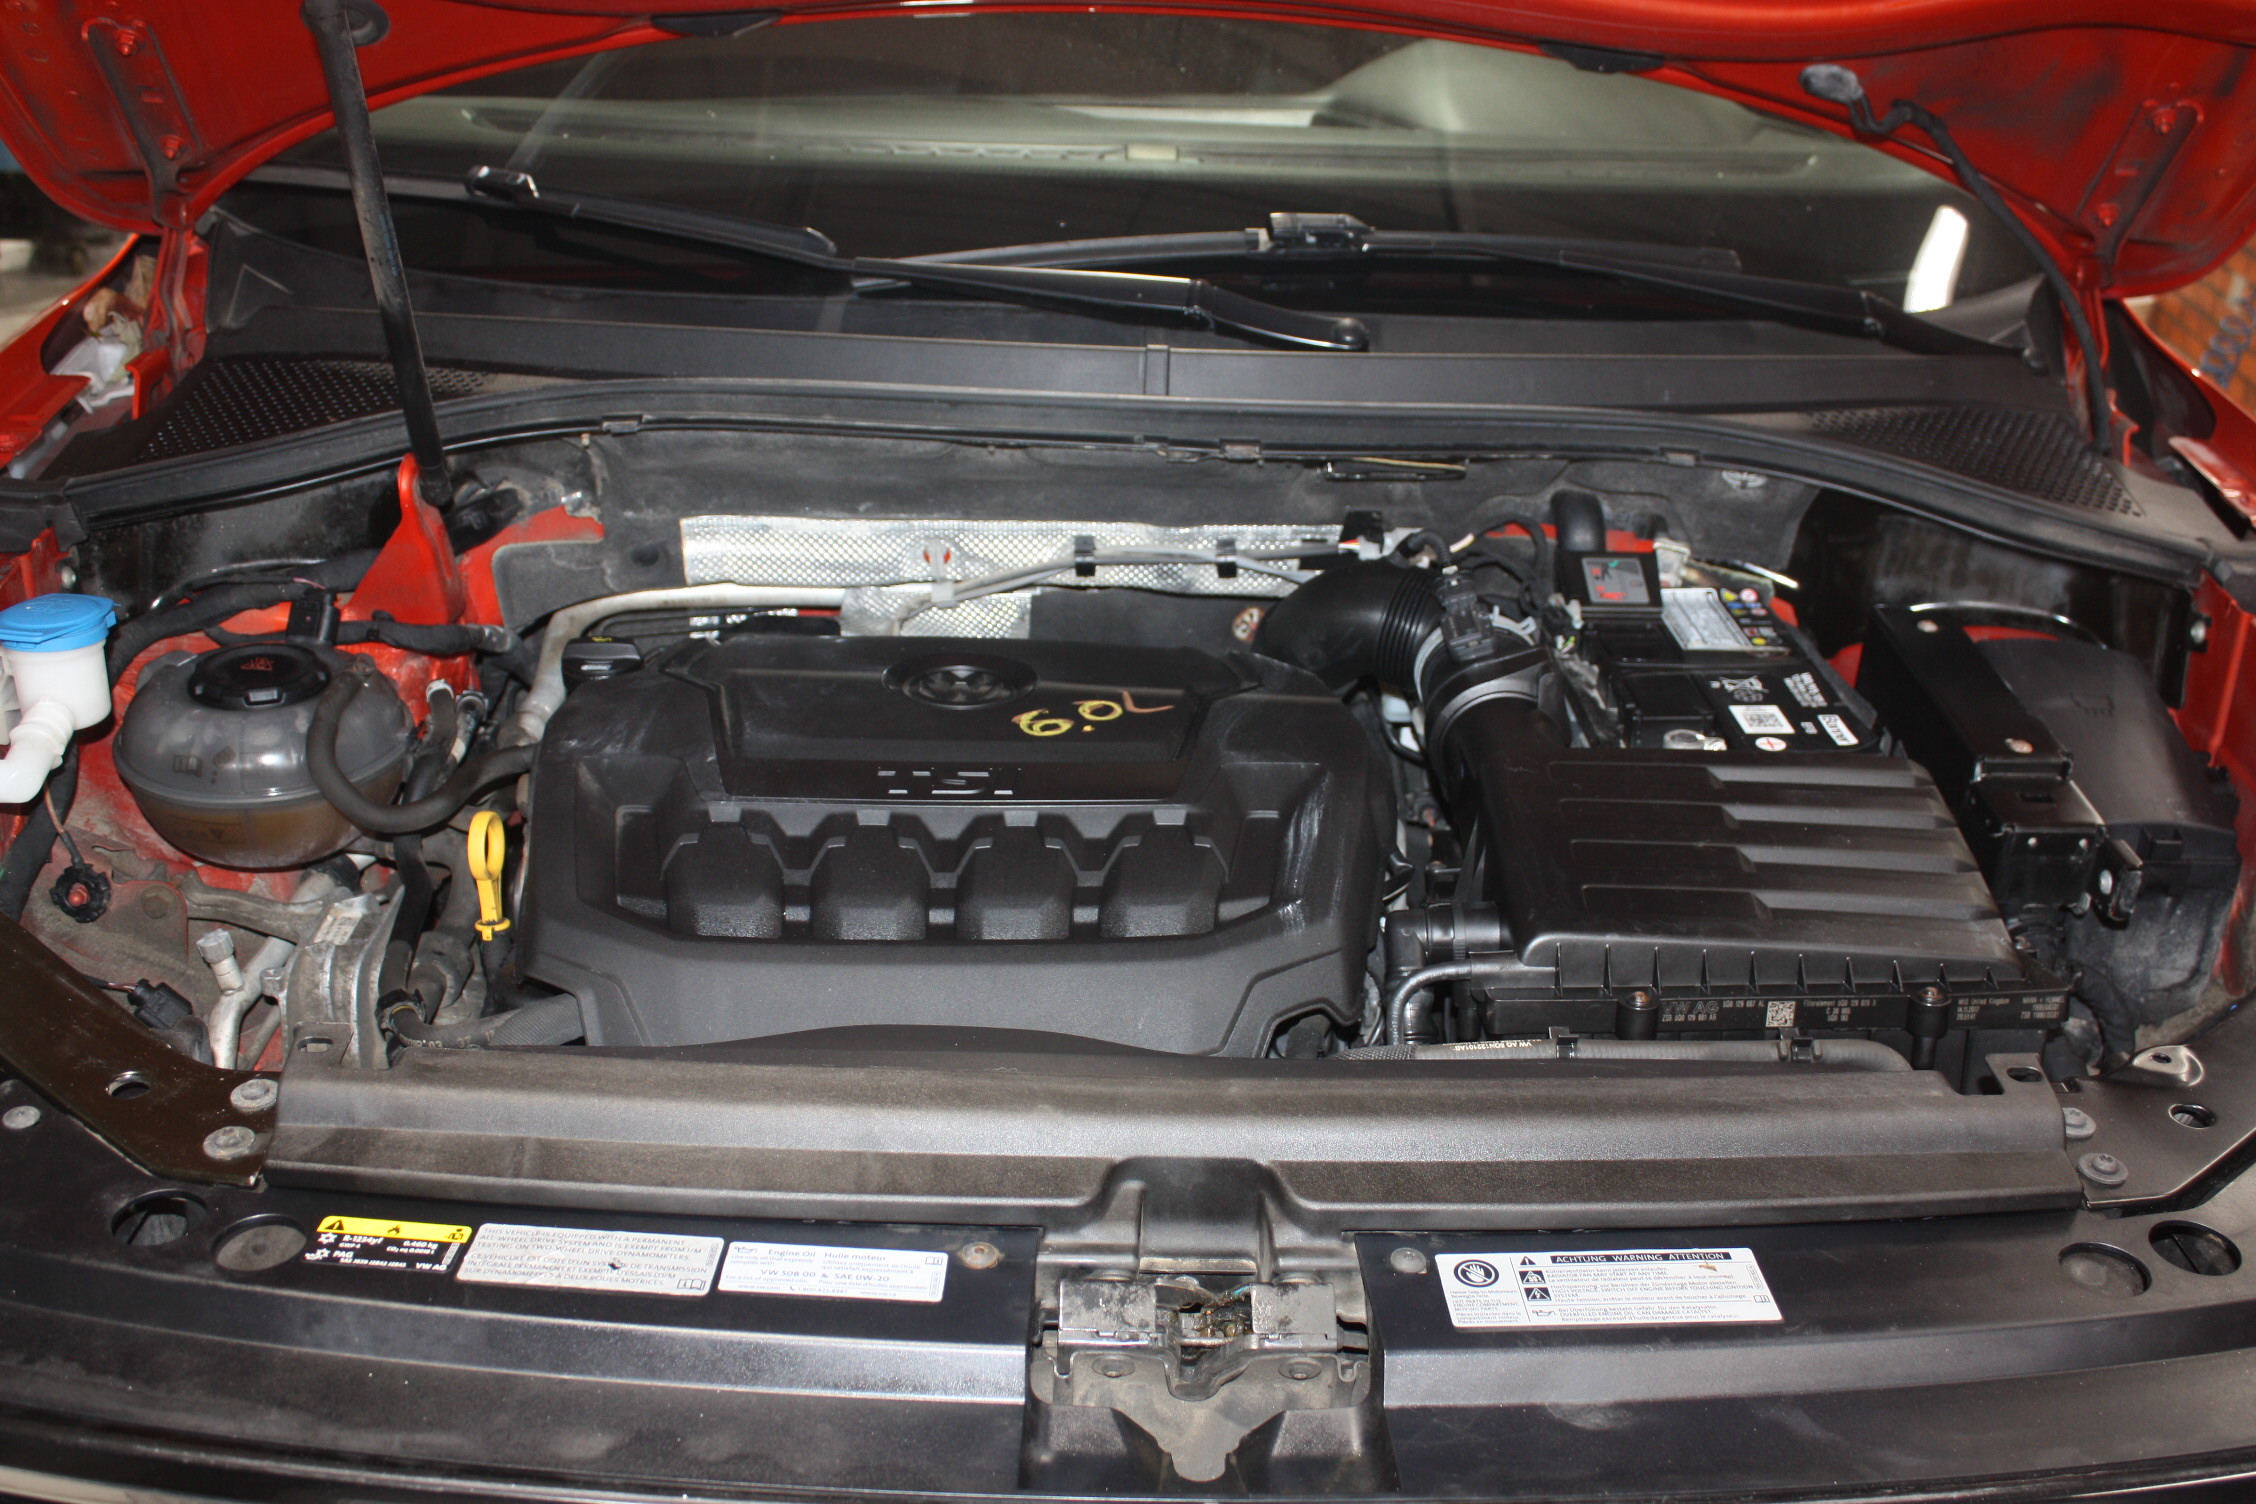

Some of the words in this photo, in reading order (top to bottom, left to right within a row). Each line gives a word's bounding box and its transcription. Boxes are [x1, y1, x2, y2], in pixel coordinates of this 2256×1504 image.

[1662, 1000, 1691, 1014] VW
[1693, 1000, 1719, 1013] AG
[552, 1232, 597, 1240] EQUIPPED
[342, 1234, 385, 1246] R-1234yf
[427, 1242, 438, 1250] kg
[332, 1250, 354, 1258] PAG
[616, 1251, 691, 1260] DYNAMOMETERS
[768, 1249, 801, 1257] Engine
[415, 1262, 432, 1270] VW
[432, 1263, 447, 1271] AG
[644, 1265, 708, 1273] TRANSMISSION
[591, 1275, 620, 1283] ROUES
